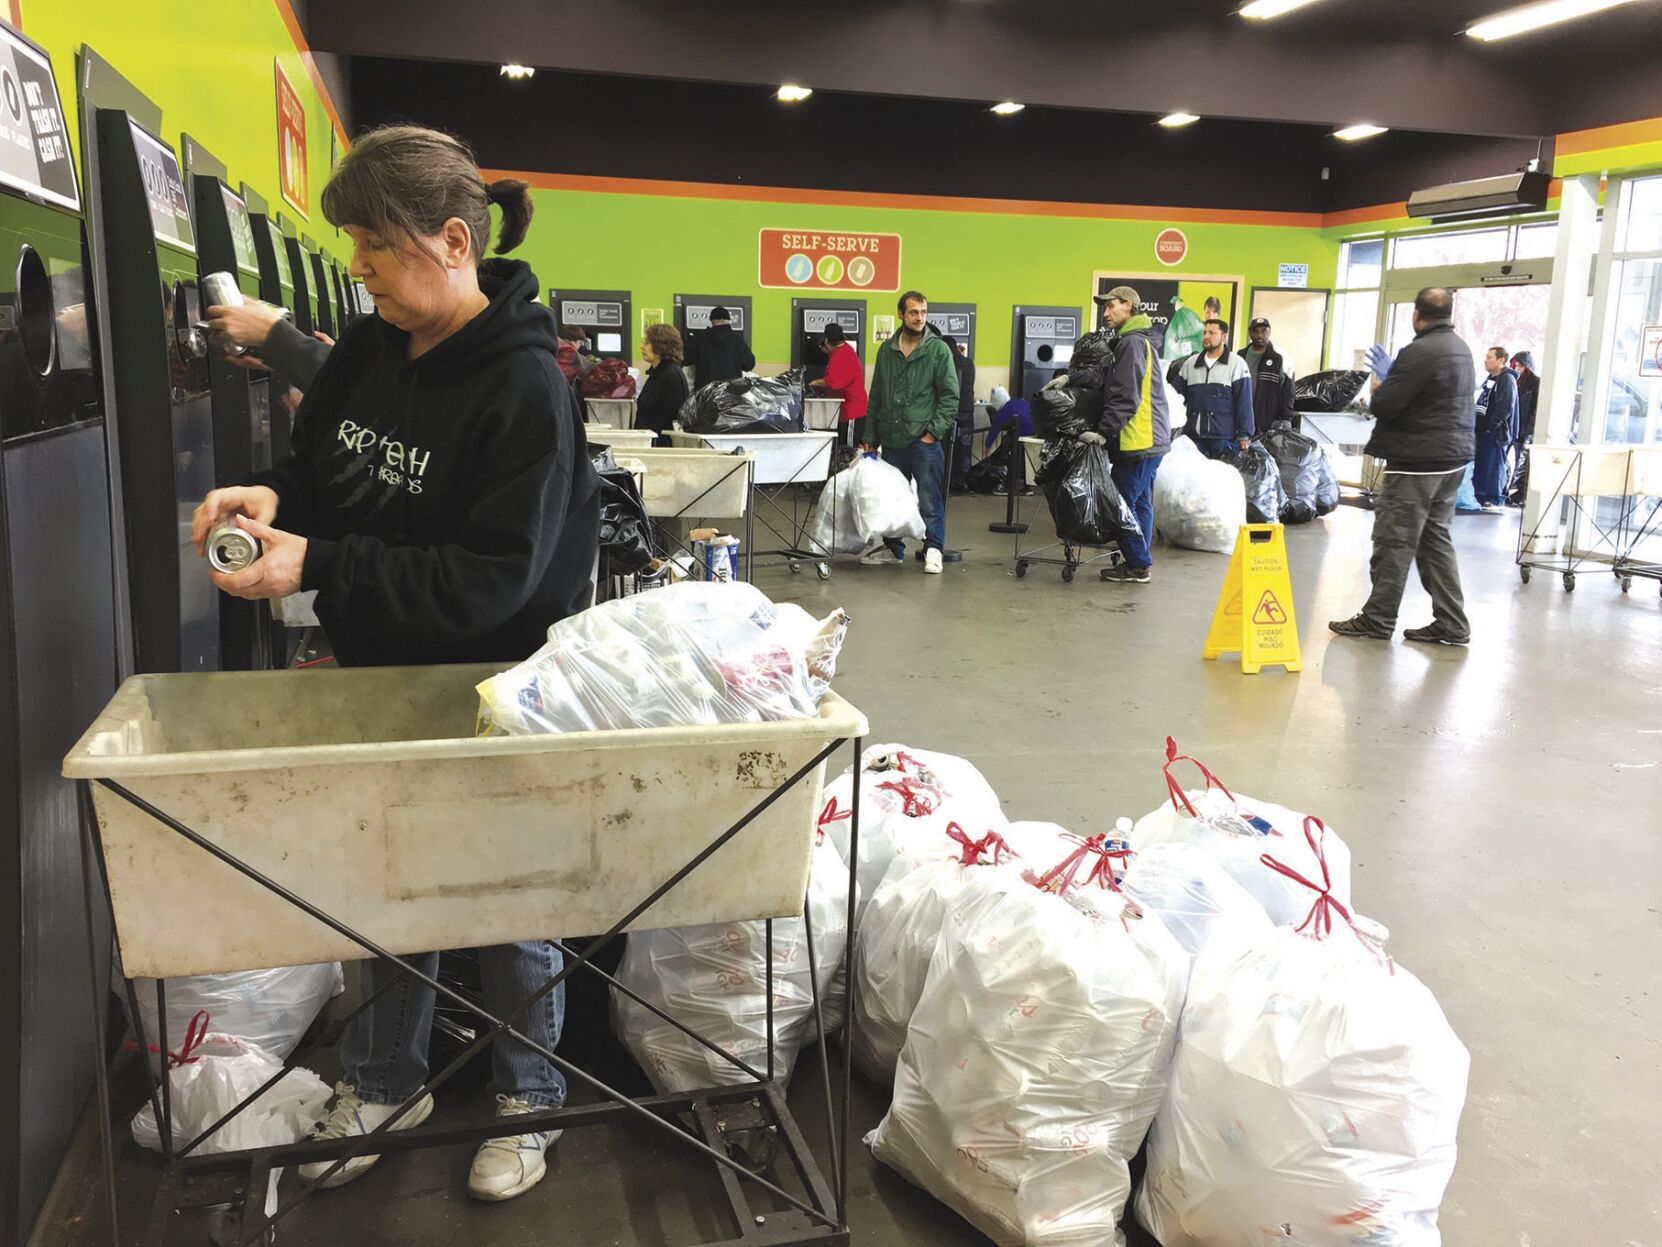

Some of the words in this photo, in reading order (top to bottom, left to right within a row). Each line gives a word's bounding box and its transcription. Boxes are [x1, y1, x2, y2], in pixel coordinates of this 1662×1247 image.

[30, 108, 52, 135] TRASH
[38, 136, 56, 163] CASH
[782, 234, 880, 253] SELF-SERVE
[1280, 264, 1306, 273] NOTICE
[1140, 302, 1160, 312] our
